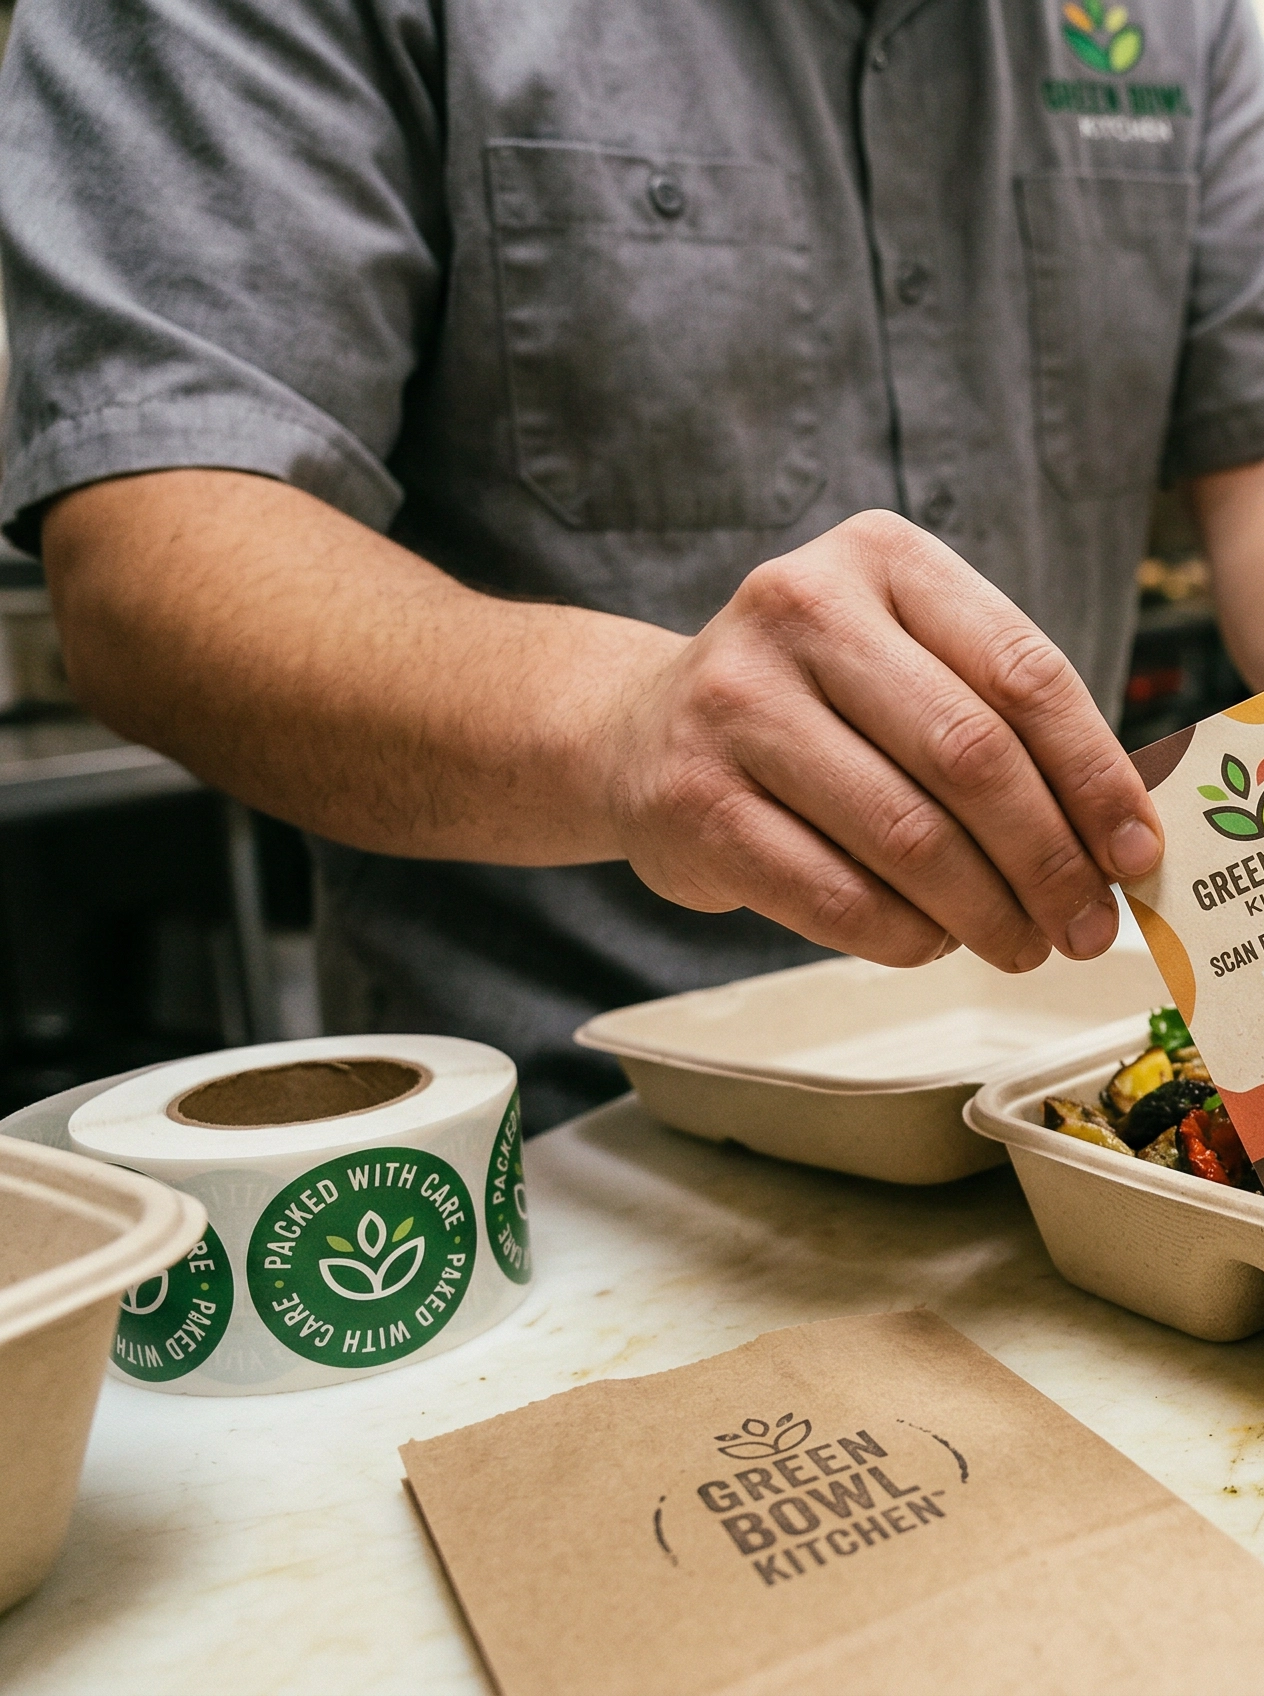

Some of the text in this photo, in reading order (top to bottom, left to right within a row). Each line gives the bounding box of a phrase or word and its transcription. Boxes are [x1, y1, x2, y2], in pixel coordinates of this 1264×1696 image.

[1209, 940, 1259, 977] SCAN
[264, 1179, 339, 1269] PACKED
[347, 1162, 418, 1191] WITH
[420, 1173, 465, 1231] CARE
[271, 1292, 335, 1347] CARE
[415, 1253, 466, 1327] PAKED
[116, 1334, 164, 1368] WITH
[165, 1298, 217, 1360] PAKED
[342, 1320, 411, 1353] WITH
[697, 1429, 888, 1513] GREEN
[721, 1466, 921, 1556] BOWL
